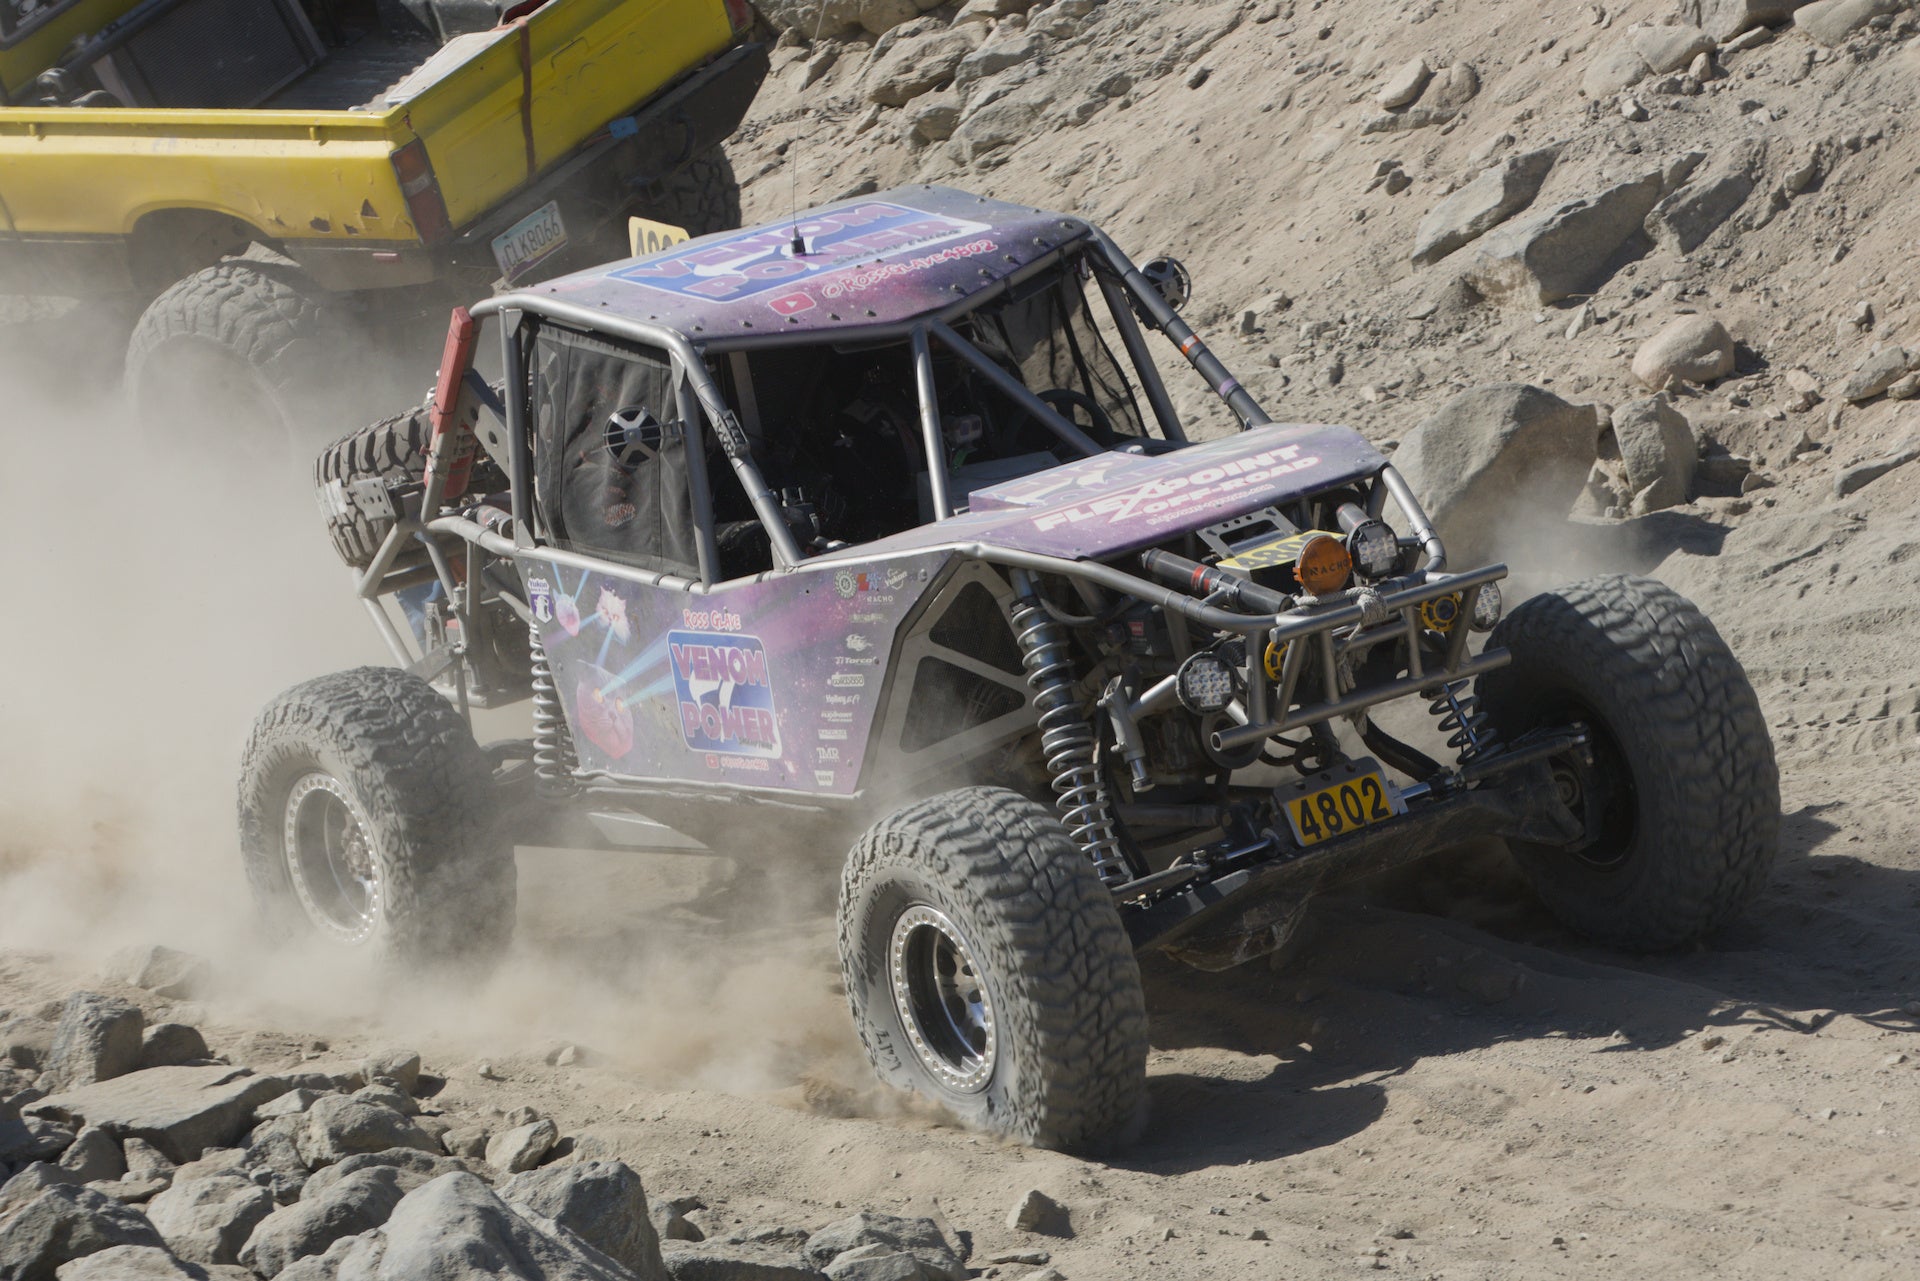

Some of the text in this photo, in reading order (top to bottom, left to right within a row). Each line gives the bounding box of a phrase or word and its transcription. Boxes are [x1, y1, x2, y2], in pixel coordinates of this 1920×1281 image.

[504, 214, 561, 267] CLK8066
[628, 203, 906, 279] VENOM
[681, 219, 964, 298] POWER
[1142, 455, 1322, 514] OFF-ROAD
[683, 608, 742, 631] ROSS GLAVE
[671, 643, 768, 687] VENOM
[680, 701, 777, 745] POWER
[1300, 776, 1390, 840] 4802
